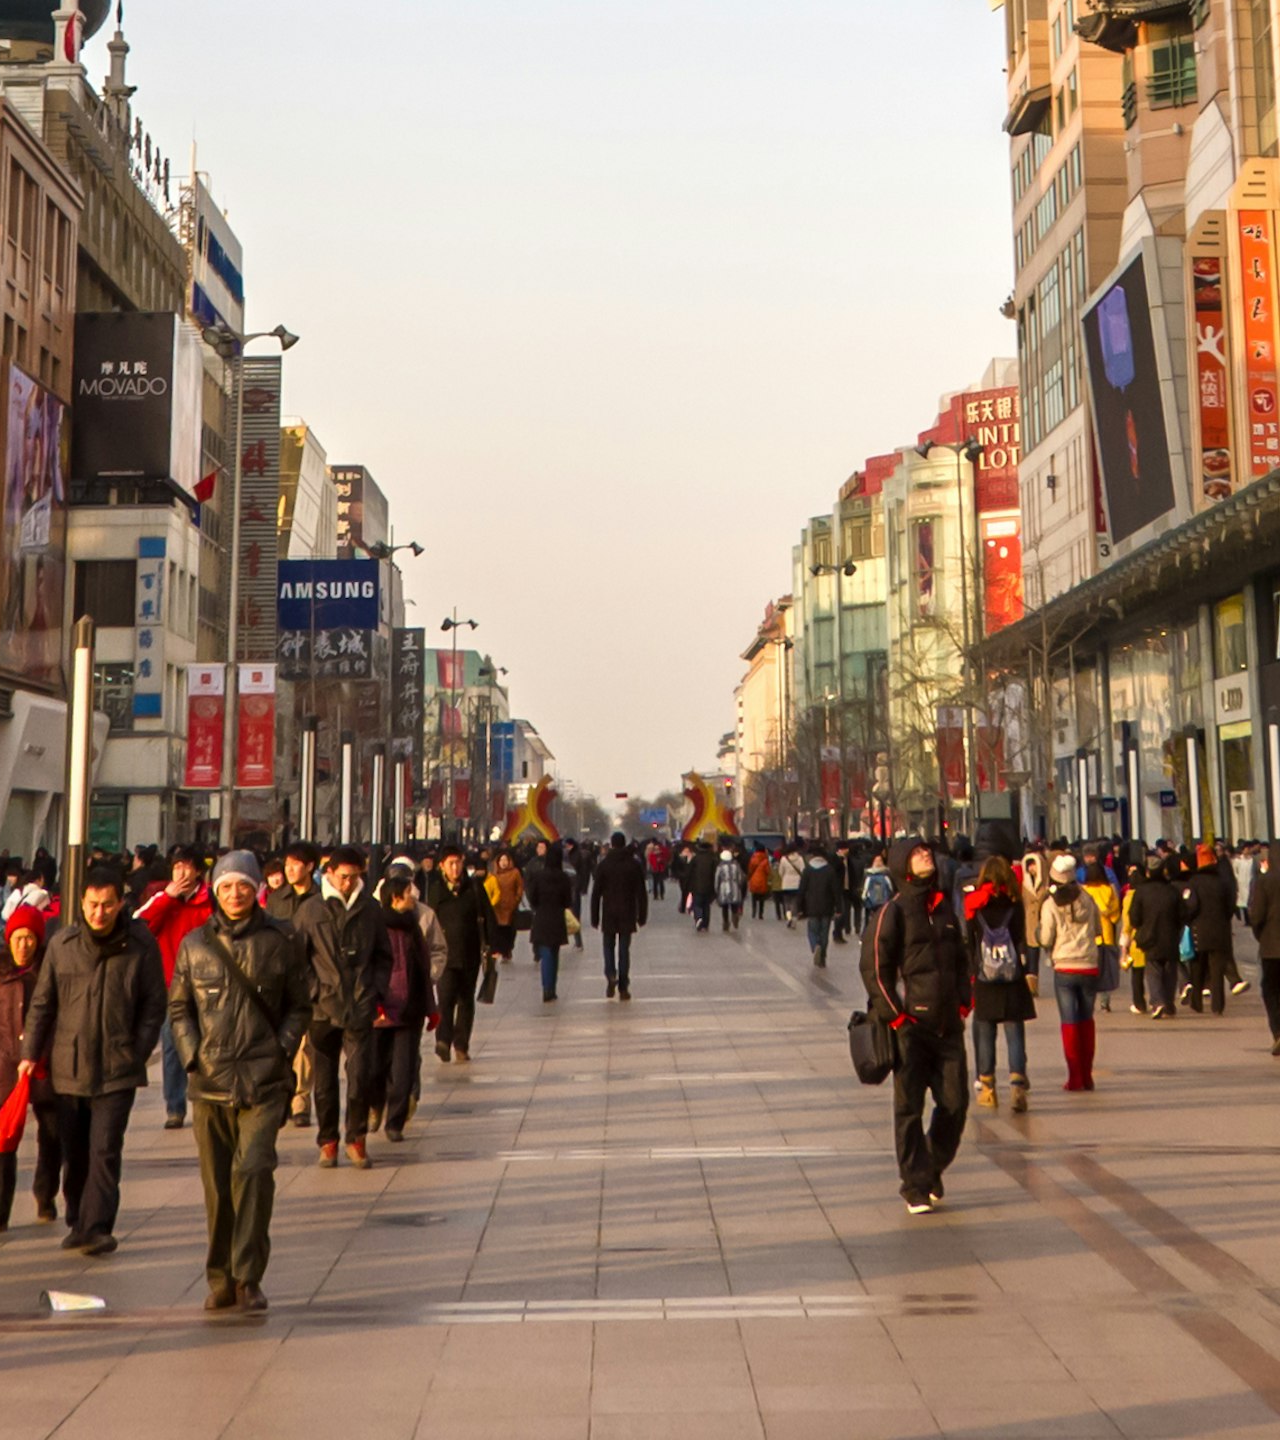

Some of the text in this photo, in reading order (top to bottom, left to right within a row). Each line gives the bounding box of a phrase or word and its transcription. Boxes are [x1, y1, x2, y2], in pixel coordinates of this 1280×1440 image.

[80, 377, 167, 395] MOVADO
[966, 396, 1020, 424] 乐天银
[1100, 543, 1111, 557] 3
